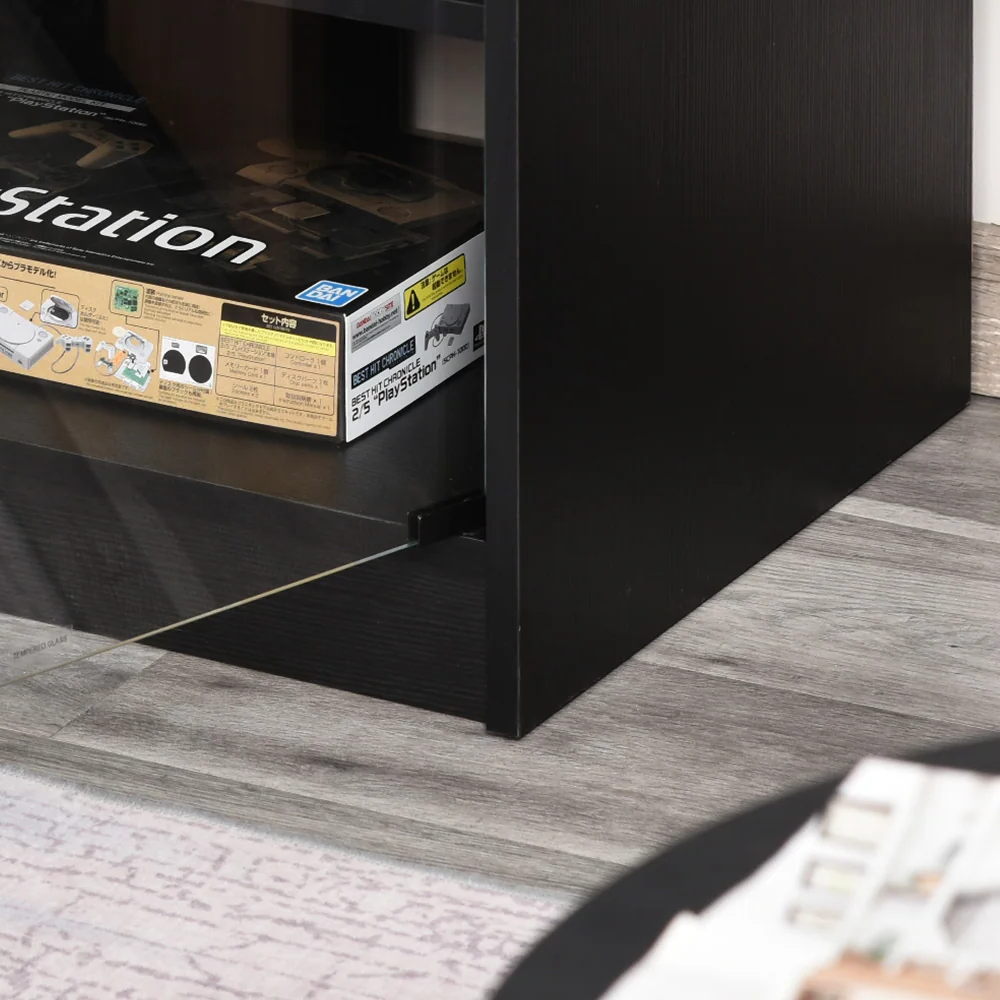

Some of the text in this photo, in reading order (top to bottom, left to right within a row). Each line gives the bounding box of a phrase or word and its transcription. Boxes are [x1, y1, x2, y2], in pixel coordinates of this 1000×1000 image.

[305, 290, 341, 302] DAI
[315, 284, 359, 297] BAN
[353, 340, 415, 385] BEST HIT CHRONICLE
[352, 358, 421, 407] BEST HIT CHRONICLE
[352, 400, 371, 421] 2/5
[13, 635, 68, 660] TEMPERED GLASS
